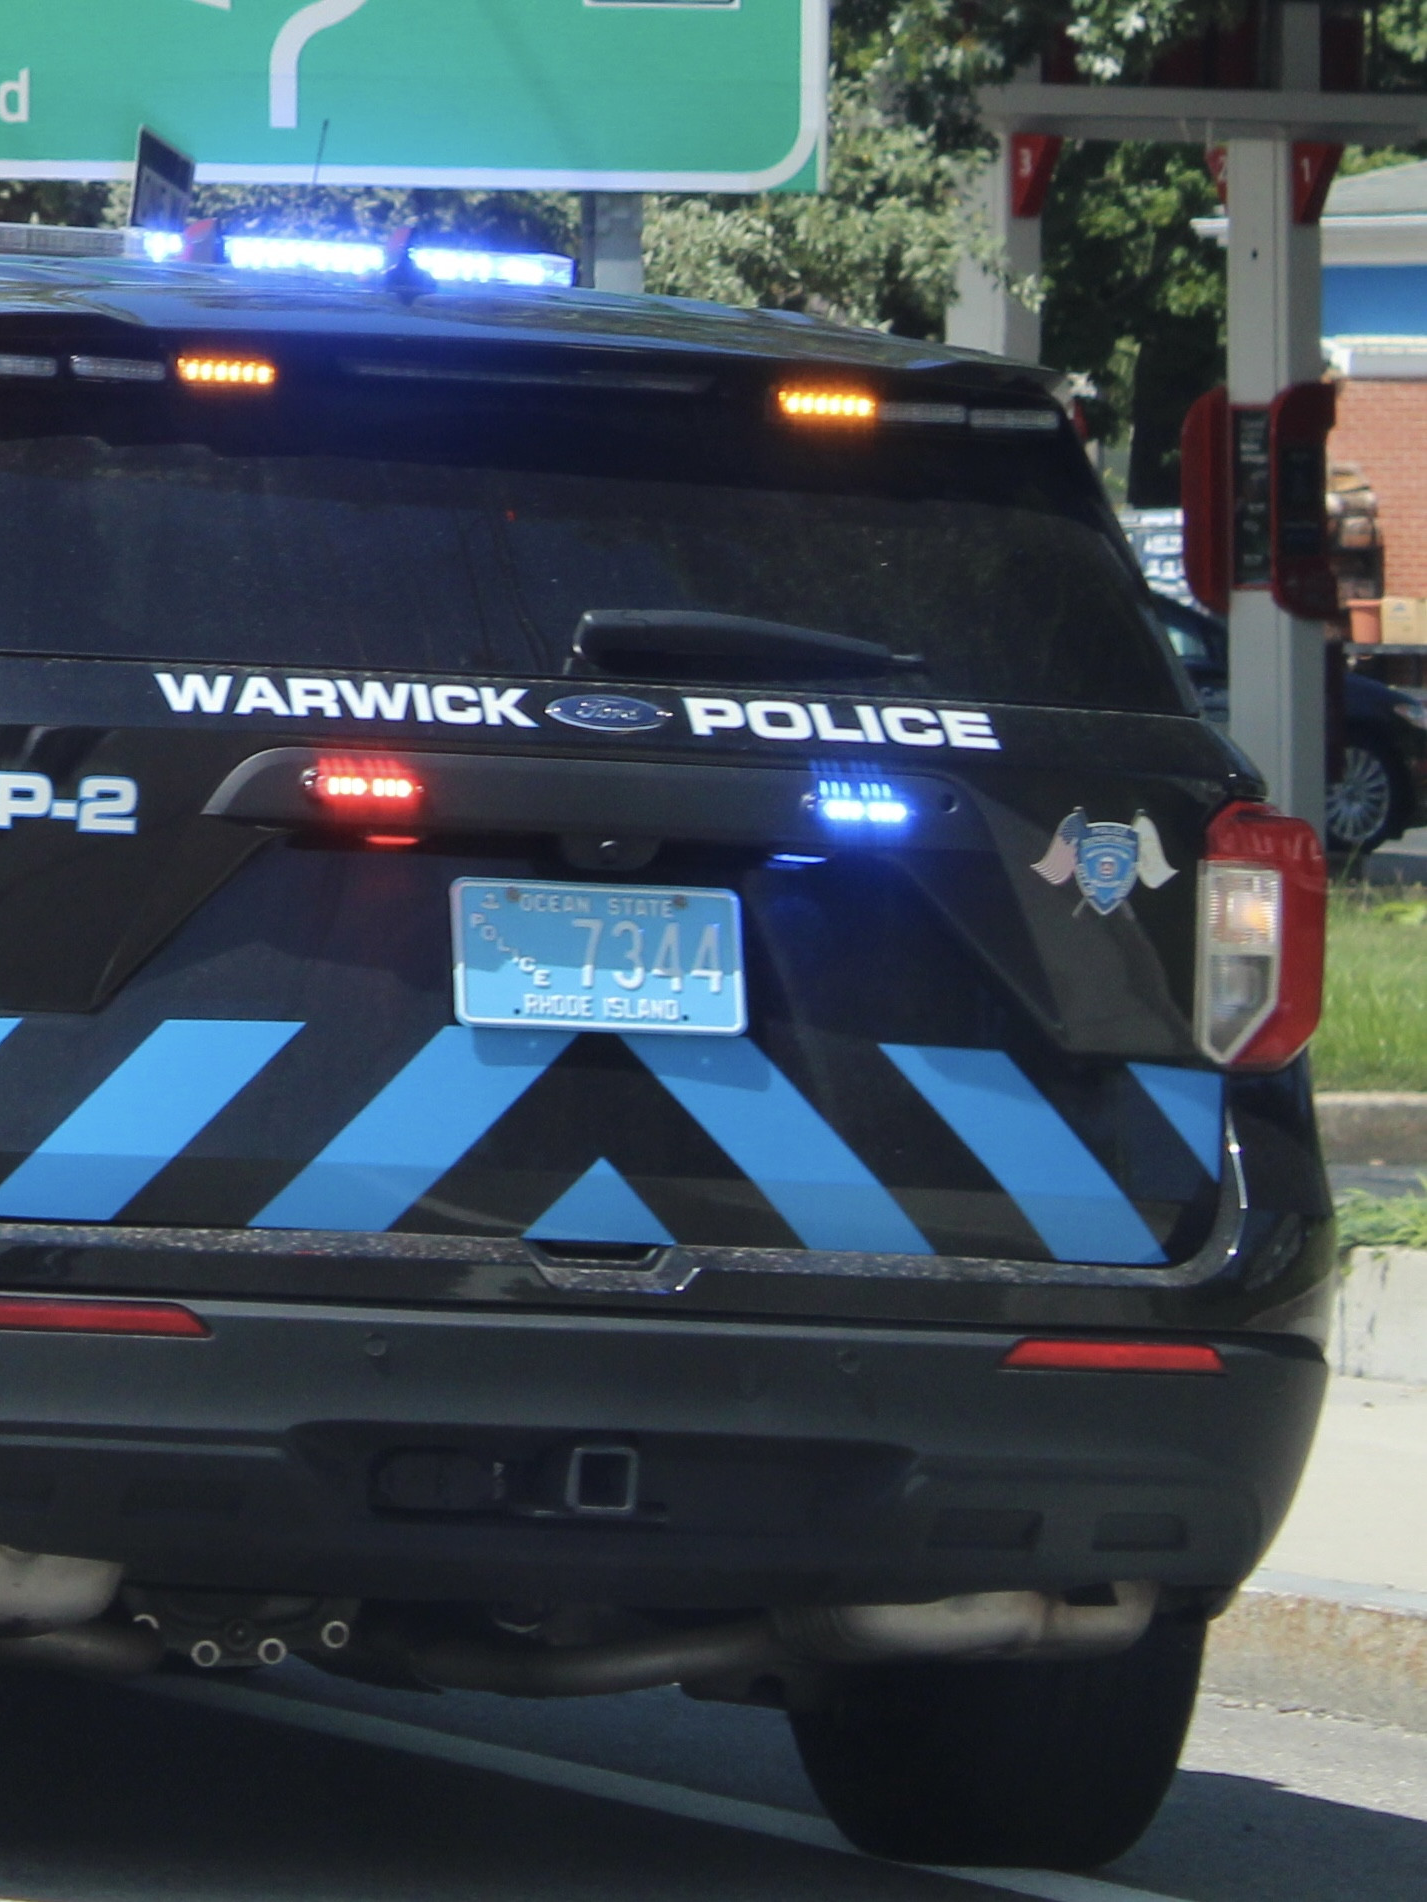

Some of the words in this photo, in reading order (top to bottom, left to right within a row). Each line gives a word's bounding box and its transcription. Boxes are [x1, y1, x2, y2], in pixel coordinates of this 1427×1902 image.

[154, 671, 541, 729] WARWICK
[682, 696, 1002, 751] POLICE
[521, 892, 591, 914] OCEAN
[607, 896, 675, 919] STATE
[572, 917, 725, 994] 7344
[523, 992, 594, 1018] RHODE
[604, 996, 682, 1021] ISLAND
